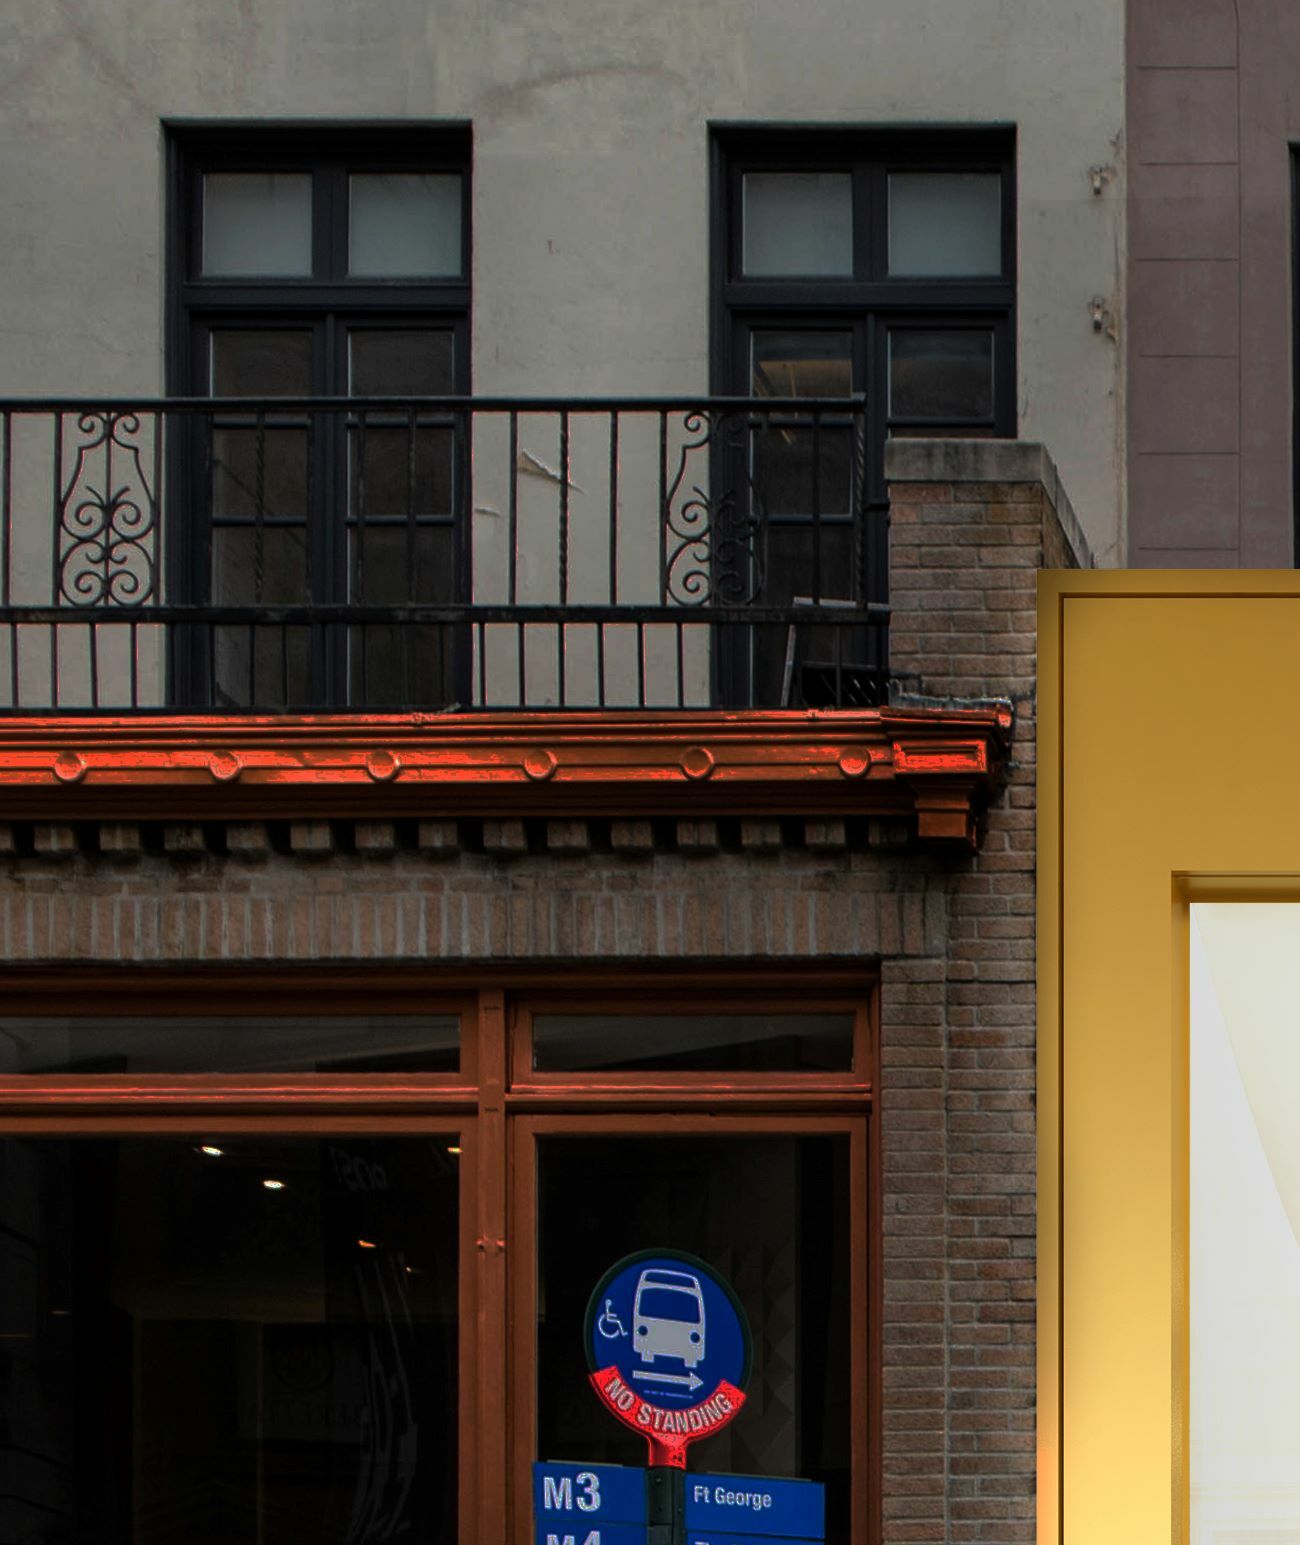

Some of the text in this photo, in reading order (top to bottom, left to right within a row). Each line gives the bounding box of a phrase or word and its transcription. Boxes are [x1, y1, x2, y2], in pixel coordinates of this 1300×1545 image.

[604, 1378, 732, 1433] NO STANDING
[543, 1471, 602, 1512] M3
[693, 1485, 772, 1511] Ft George
